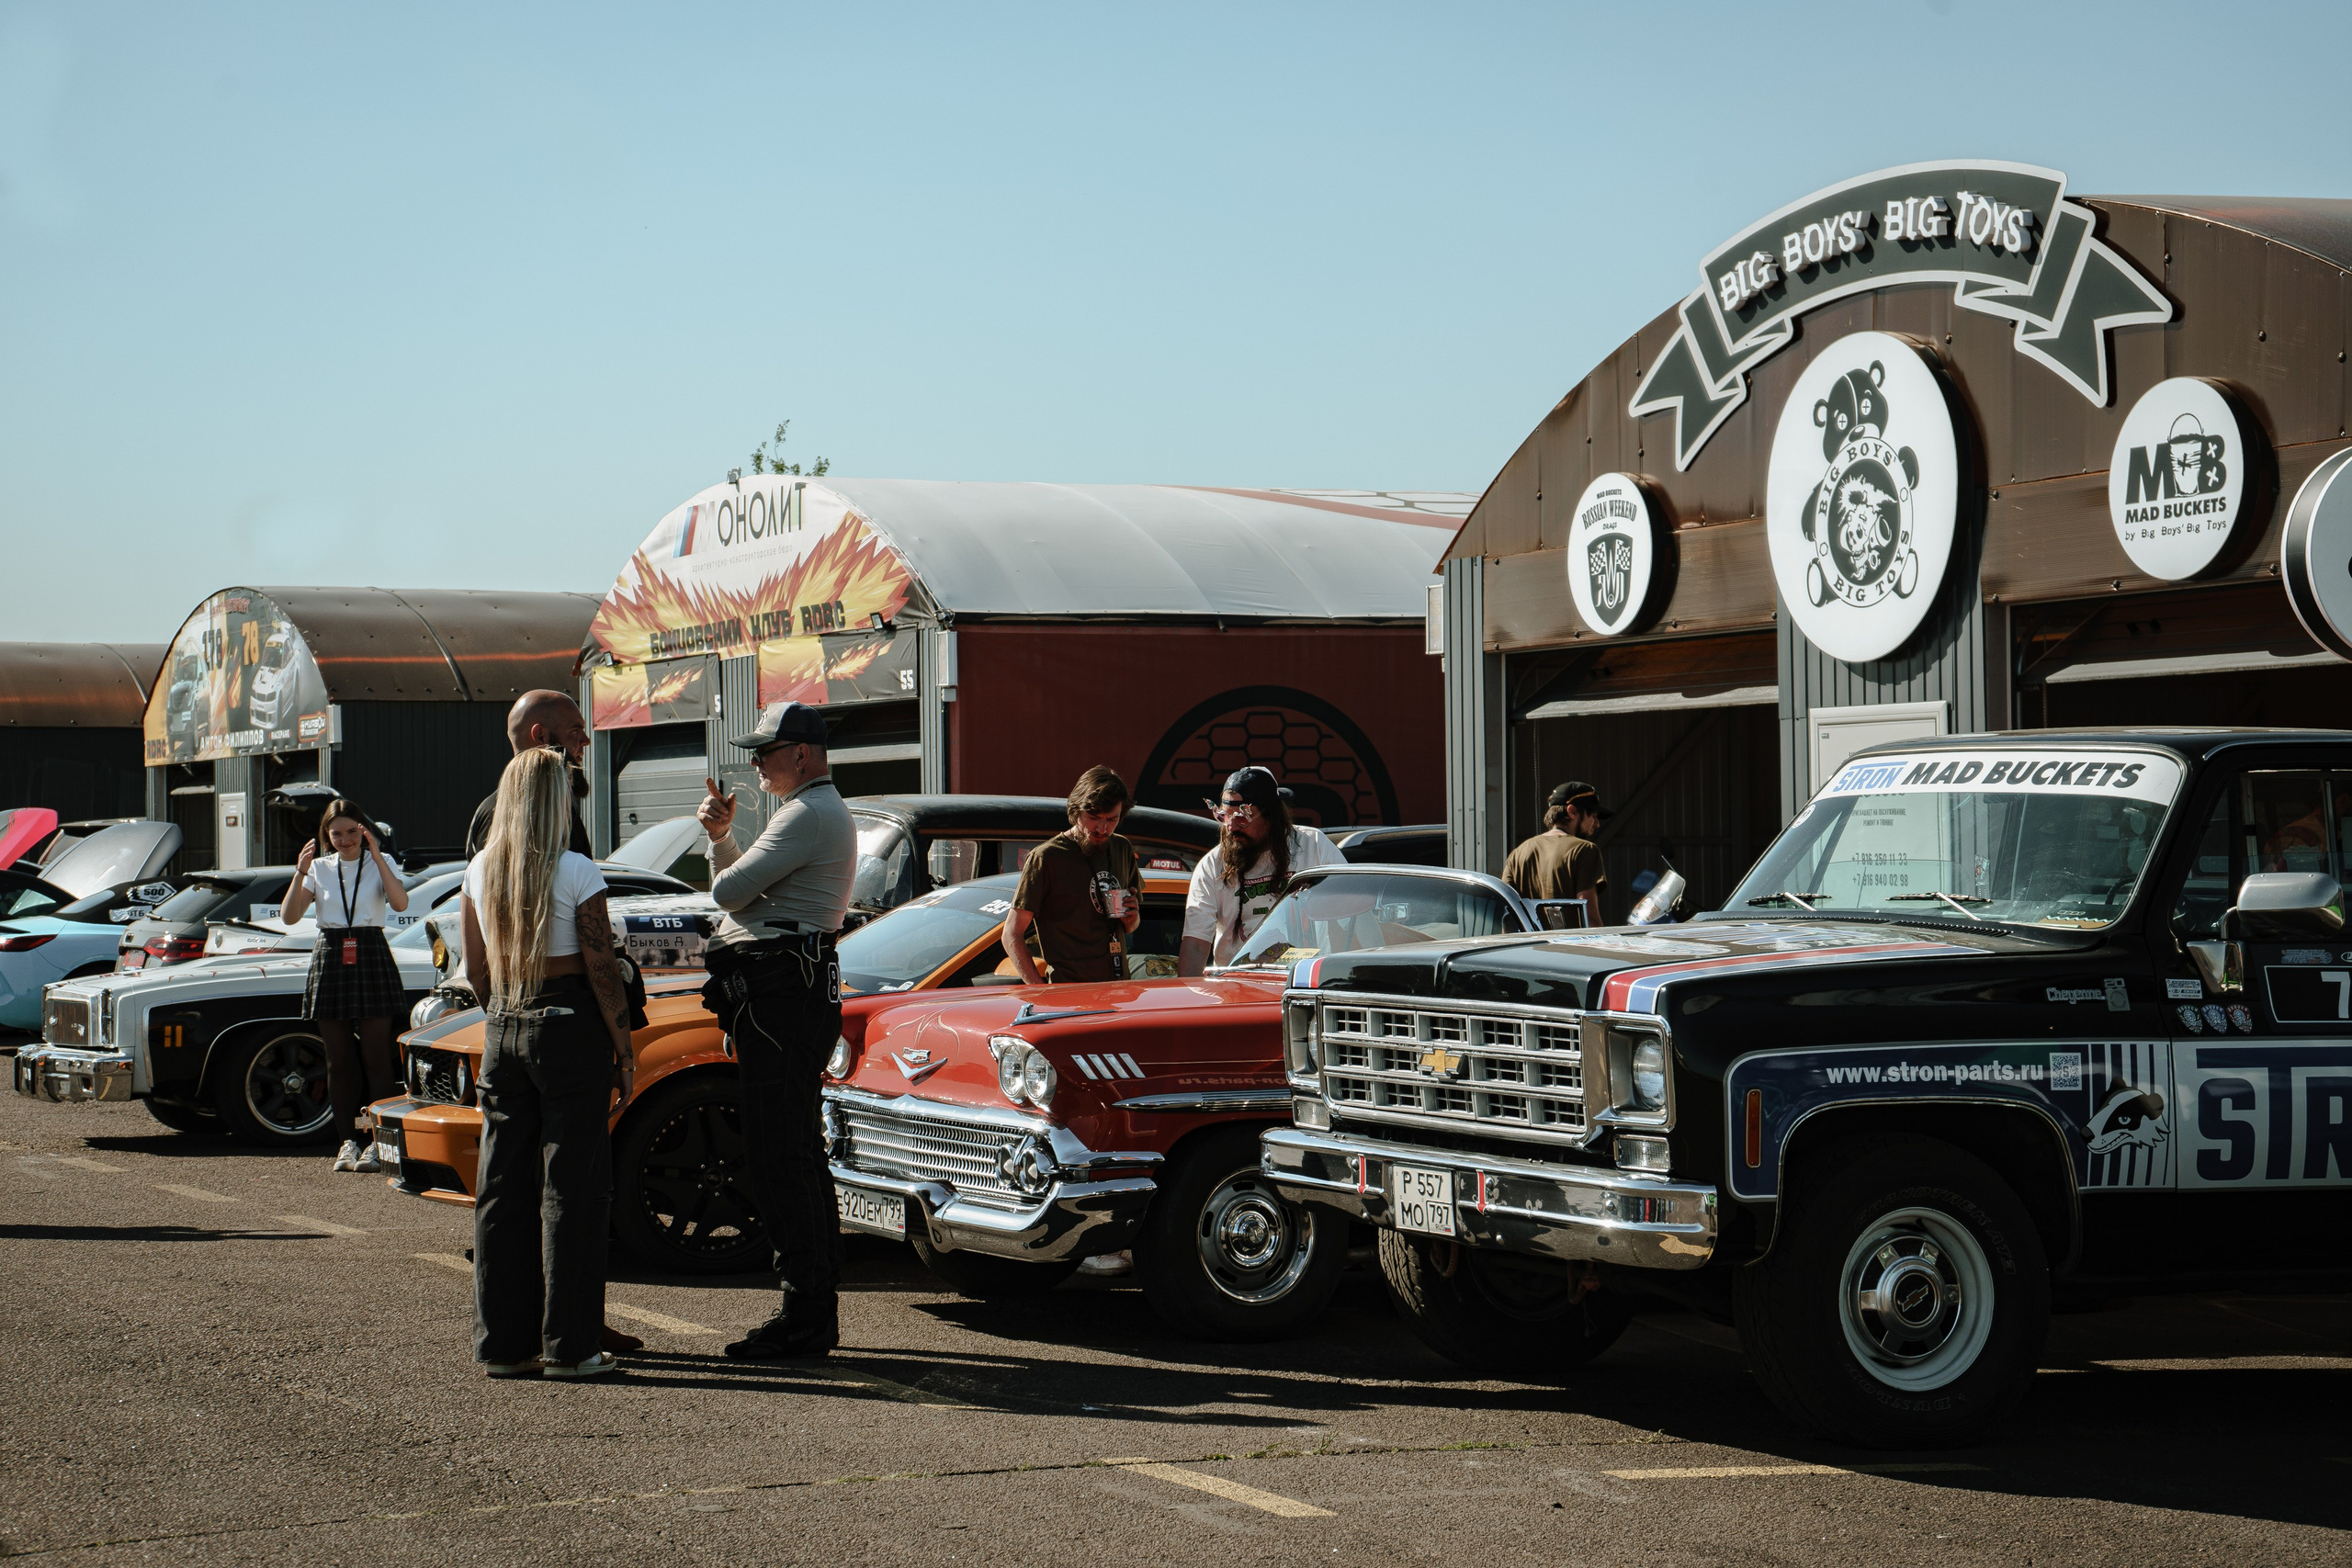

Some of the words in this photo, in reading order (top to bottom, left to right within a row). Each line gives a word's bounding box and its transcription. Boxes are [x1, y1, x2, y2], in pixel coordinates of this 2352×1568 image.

[1720, 250, 1776, 311] BIG
[1884, 196, 1948, 241] BIG
[1954, 190, 2030, 253] TOYS
[1818, 466, 1840, 516] BIG
[1581, 501, 1609, 530] RUSSIAN
[1609, 500, 1638, 523] WEEKEND
[2125, 507, 2159, 525] MAD
[2164, 497, 2227, 519] BUCKETS
[2125, 530, 2136, 541] by
[2141, 528, 2155, 540] Big
[2187, 523, 2200, 534] Big
[2207, 520, 2227, 531] Toys
[1833, 574, 1866, 602] BIG
[1876, 530, 1910, 595] TOYS
[242, 620, 259, 666] 78
[650, 616, 742, 659] БОЙЦОВСКИЙ
[750, 609, 792, 643] КЛУБ
[899, 670, 914, 690] 55
[1832, 761, 1909, 793] STRON
[1901, 761, 1987, 785] MAD
[1981, 760, 2146, 789] BUCKETS
[1152, 860, 1181, 869] MOTUL
[1889, 874, 1897, 886] 02
[1900, 874, 1908, 886] 98
[270, 909, 282, 918] ВТ
[652, 918, 683, 929] ВТБ
[2046, 987, 2104, 1005] Cheyenne
[2103, 977, 2126, 990] 20
[2321, 971, 2351, 1019] 7
[1826, 1060, 2044, 1086] www.stron-parts.ru
[1402, 1170, 1412, 1194] P
[1418, 1172, 1442, 1199] 557
[883, 1197, 901, 1220] 799
[1401, 1201, 1424, 1227] MO
[1429, 1203, 1450, 1225] 797
